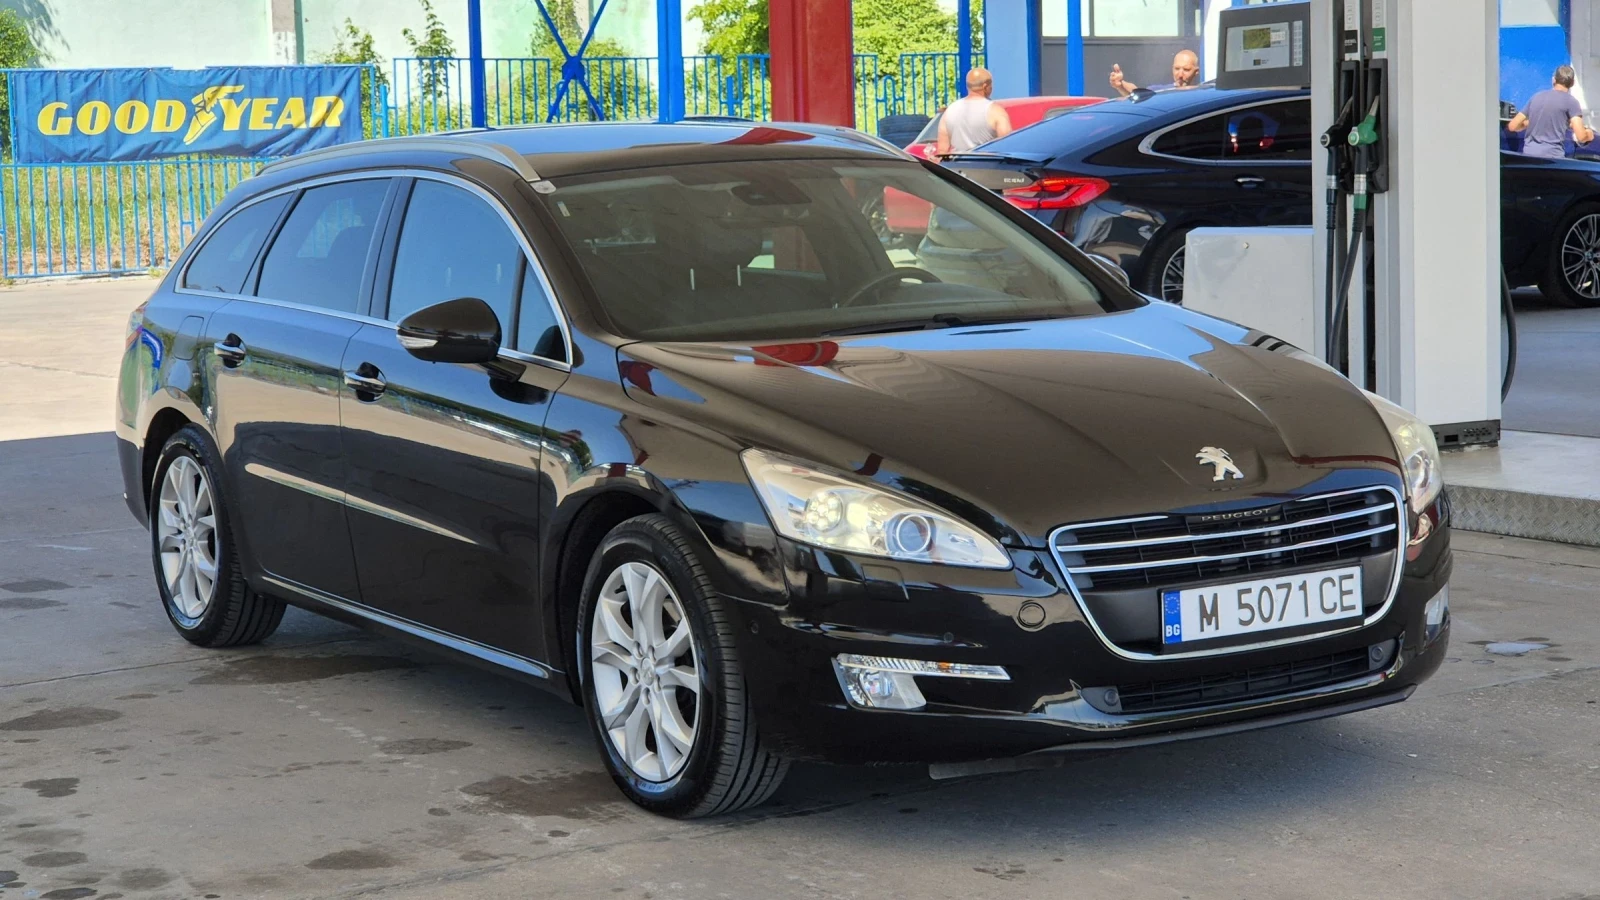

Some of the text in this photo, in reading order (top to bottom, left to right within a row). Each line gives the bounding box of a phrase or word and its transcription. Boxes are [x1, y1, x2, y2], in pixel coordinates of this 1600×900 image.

[1201, 508, 1271, 521] PEUGEOT
[1199, 593, 1220, 632] M
[1165, 624, 1181, 637] BG
